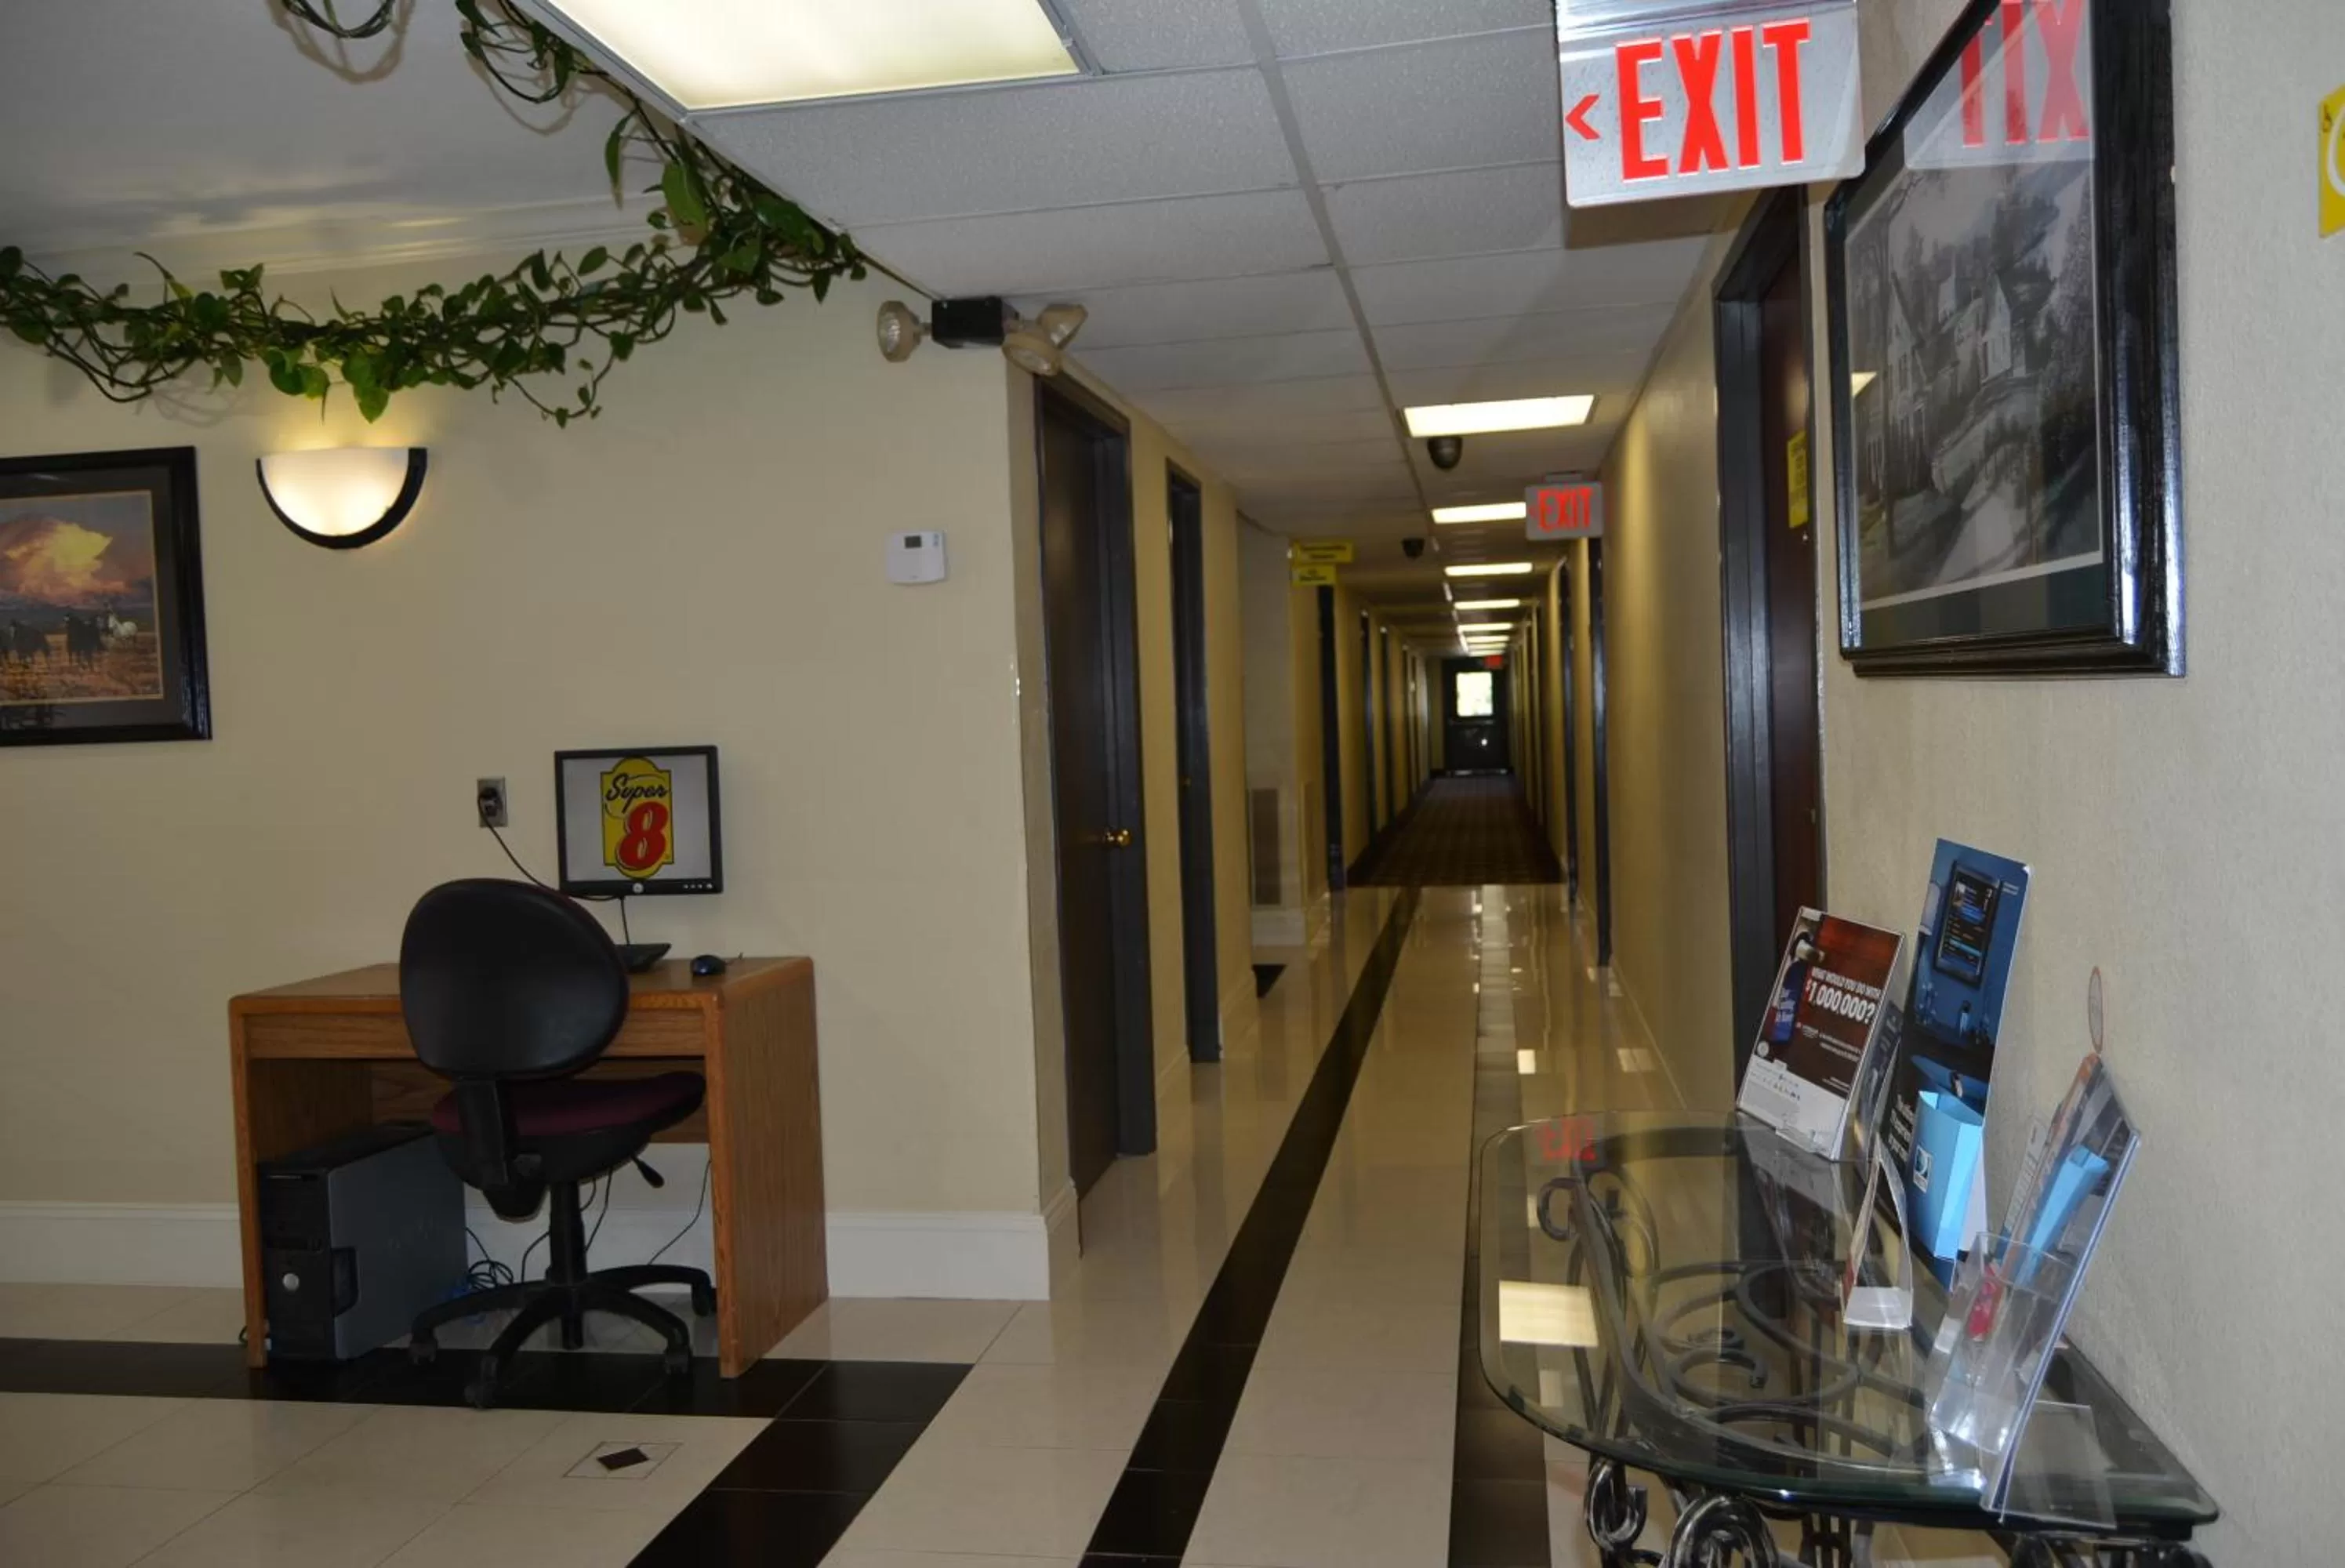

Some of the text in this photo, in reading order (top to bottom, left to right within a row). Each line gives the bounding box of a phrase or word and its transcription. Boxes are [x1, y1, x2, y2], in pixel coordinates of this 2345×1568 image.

[1616, 18, 1810, 183] EXIT
[1538, 486, 1592, 533] EXIT
[606, 773, 670, 814] Super
[615, 801, 669, 871] 8
